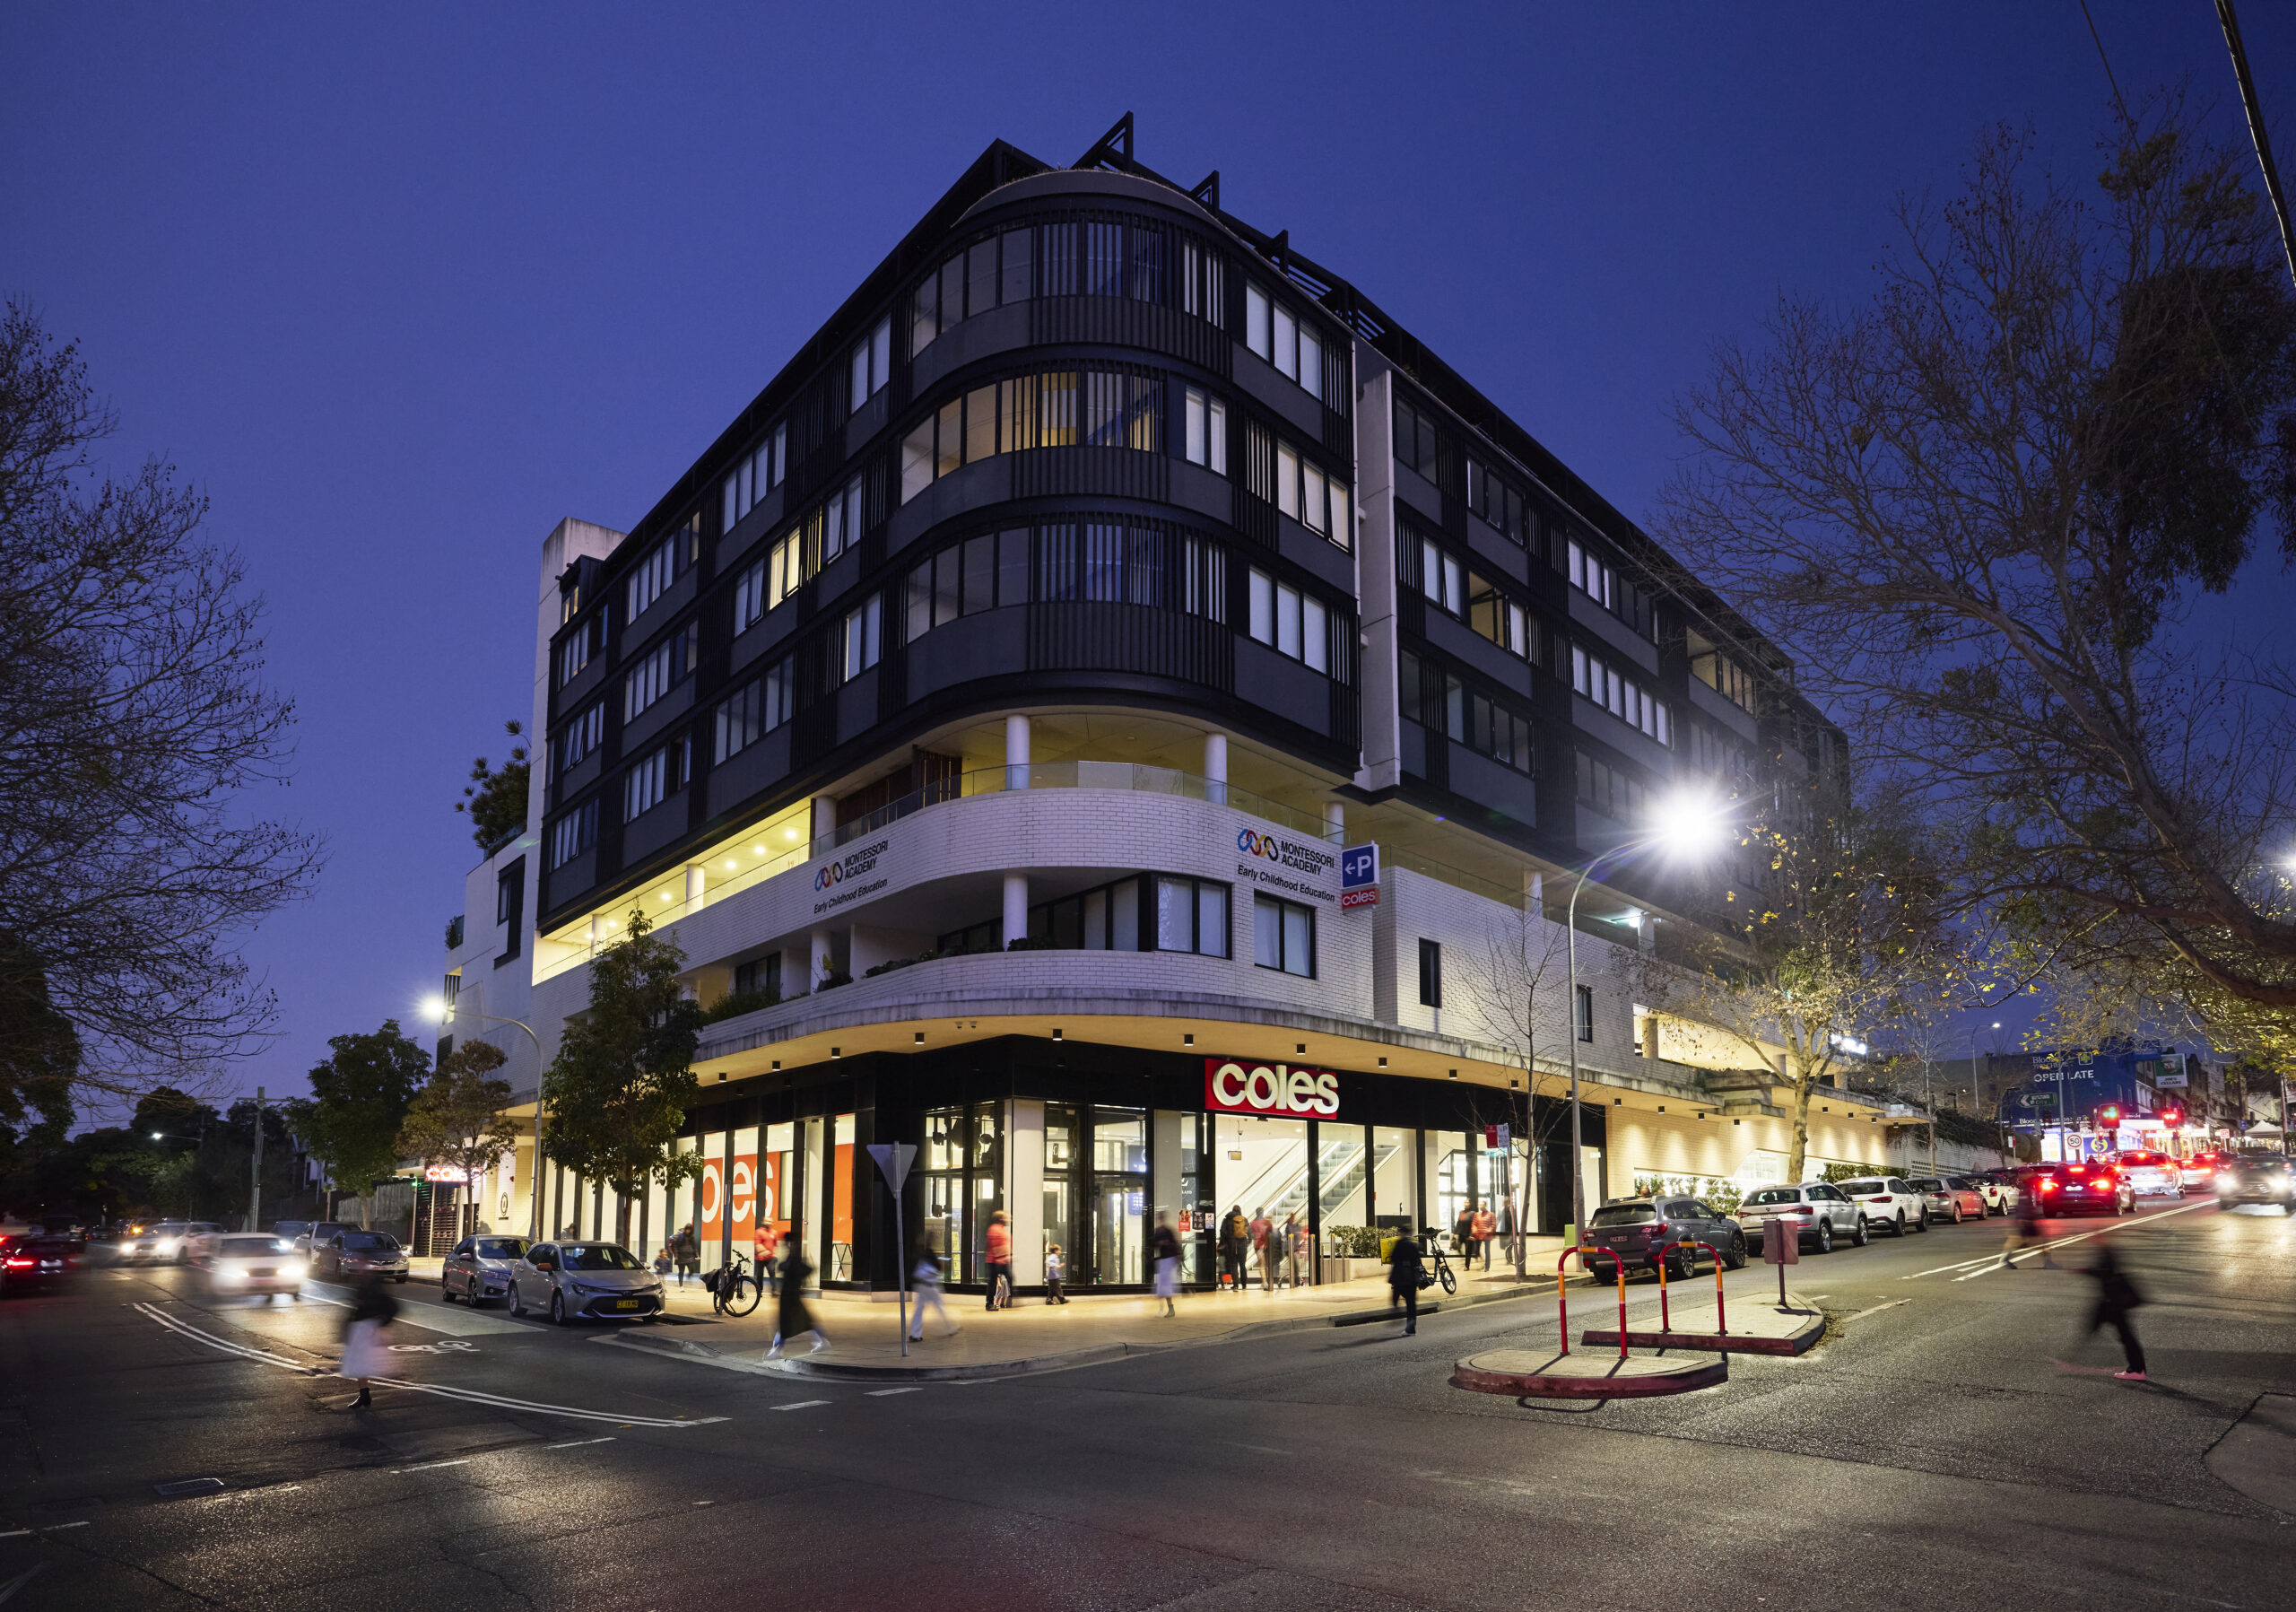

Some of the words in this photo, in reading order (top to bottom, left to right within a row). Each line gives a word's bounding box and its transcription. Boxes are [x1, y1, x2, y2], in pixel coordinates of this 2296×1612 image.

[845, 840, 888, 868] MONTESSORI
[1281, 841, 1335, 868] MONTESSORI
[1281, 854, 1322, 876] ACADEMY
[1357, 855, 1372, 877] P
[845, 857, 877, 880] ACADEMY
[814, 901, 828, 913] Early
[828, 888, 857, 908] Childhood
[857, 879, 888, 897] Education
[1238, 865, 1258, 881] Early
[1259, 872, 1298, 892] Childhood
[1300, 884, 1335, 902] Education
[1343, 891, 1376, 906] coles
[1213, 1063, 1339, 1114] coles
[2034, 1073, 2064, 1082] OPEN
[2067, 1070, 2094, 1080] LATE
[702, 1158, 773, 1223] oes
